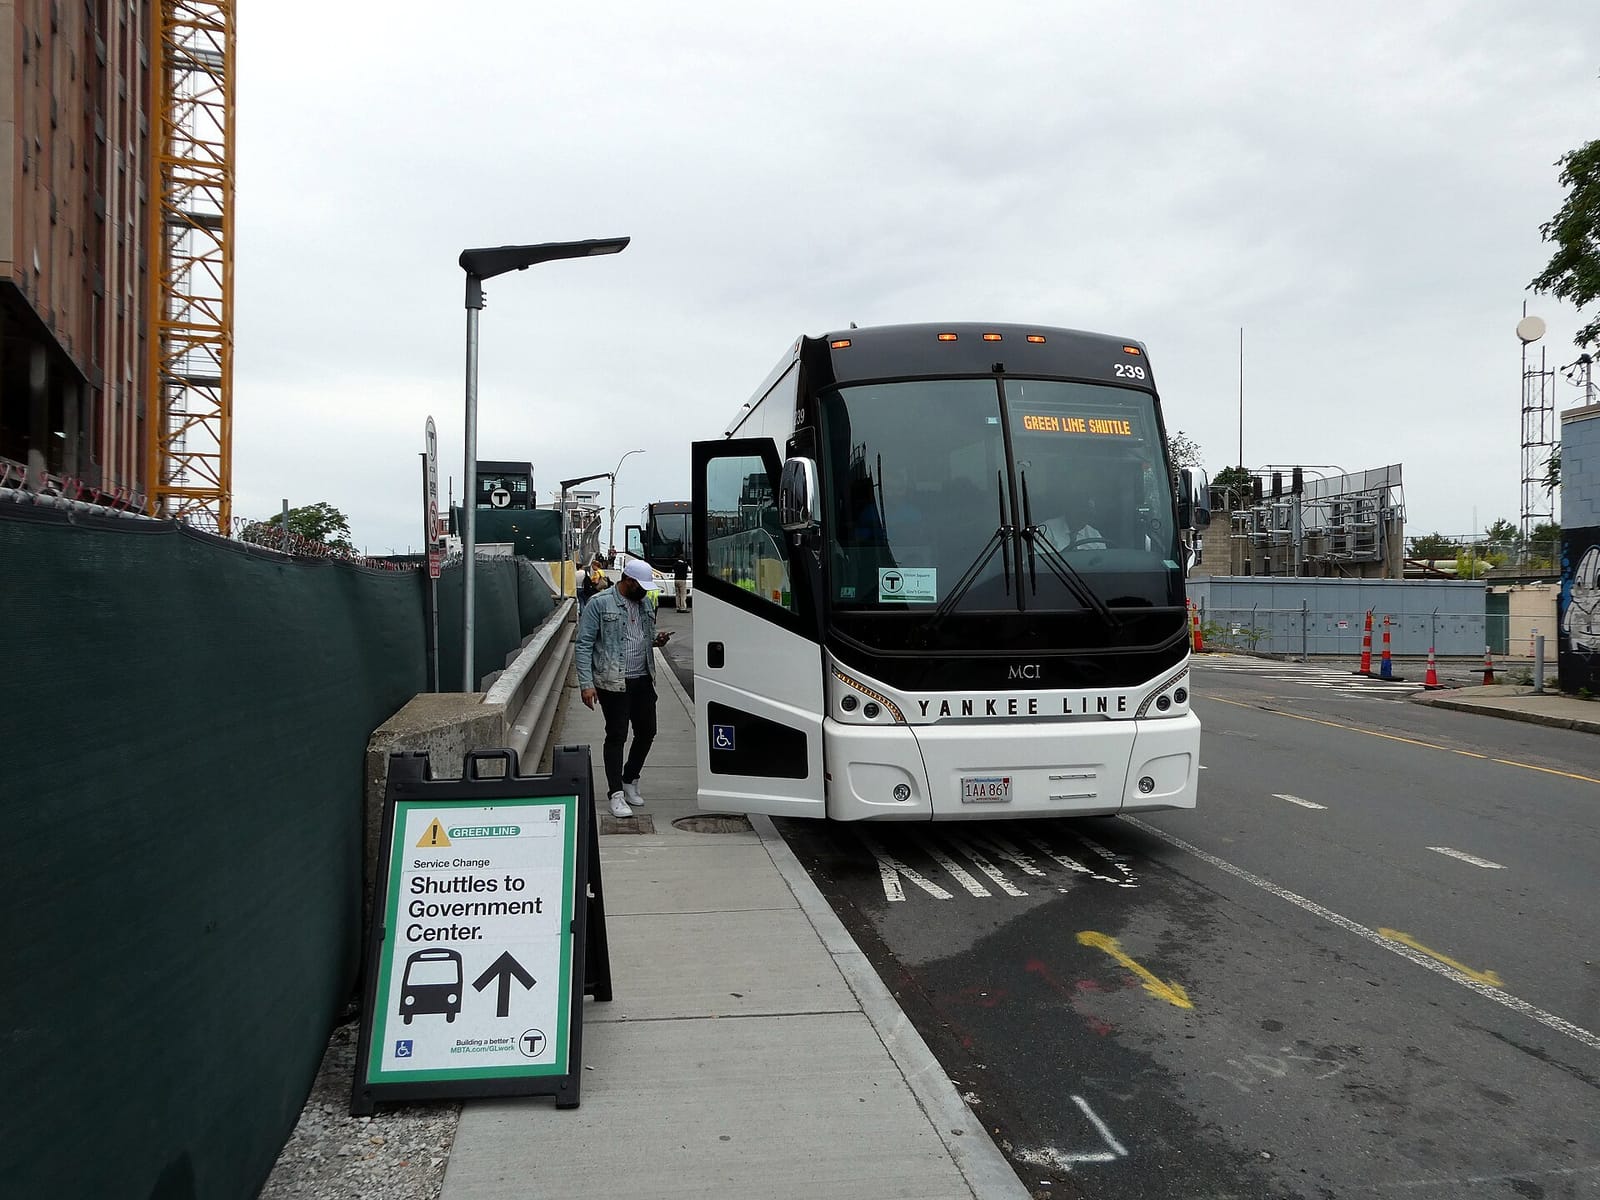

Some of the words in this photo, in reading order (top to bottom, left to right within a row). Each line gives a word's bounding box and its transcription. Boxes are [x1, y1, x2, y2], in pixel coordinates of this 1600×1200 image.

[1114, 363, 1145, 380] 239
[1023, 415, 1060, 431] GREEN
[1062, 417, 1087, 433] LINE
[1088, 419, 1131, 435] SHUTTLE
[1007, 664, 1041, 679] MCI
[918, 698, 1038, 717] YANKEE
[1063, 695, 1126, 714] LINE
[965, 783, 986, 797] 1AA
[988, 783, 1009, 796] 86Y
[453, 827, 490, 838] GREEN
[492, 826, 516, 836] LINE
[413, 859, 450, 869] Service
[452, 858, 490, 869] Change
[410, 876, 498, 895] Shuttles
[503, 875, 525, 892] to
[408, 897, 543, 918] Government
[406, 923, 483, 943] Center.
[456, 1039, 483, 1047] Building
[489, 1037, 509, 1045] better
